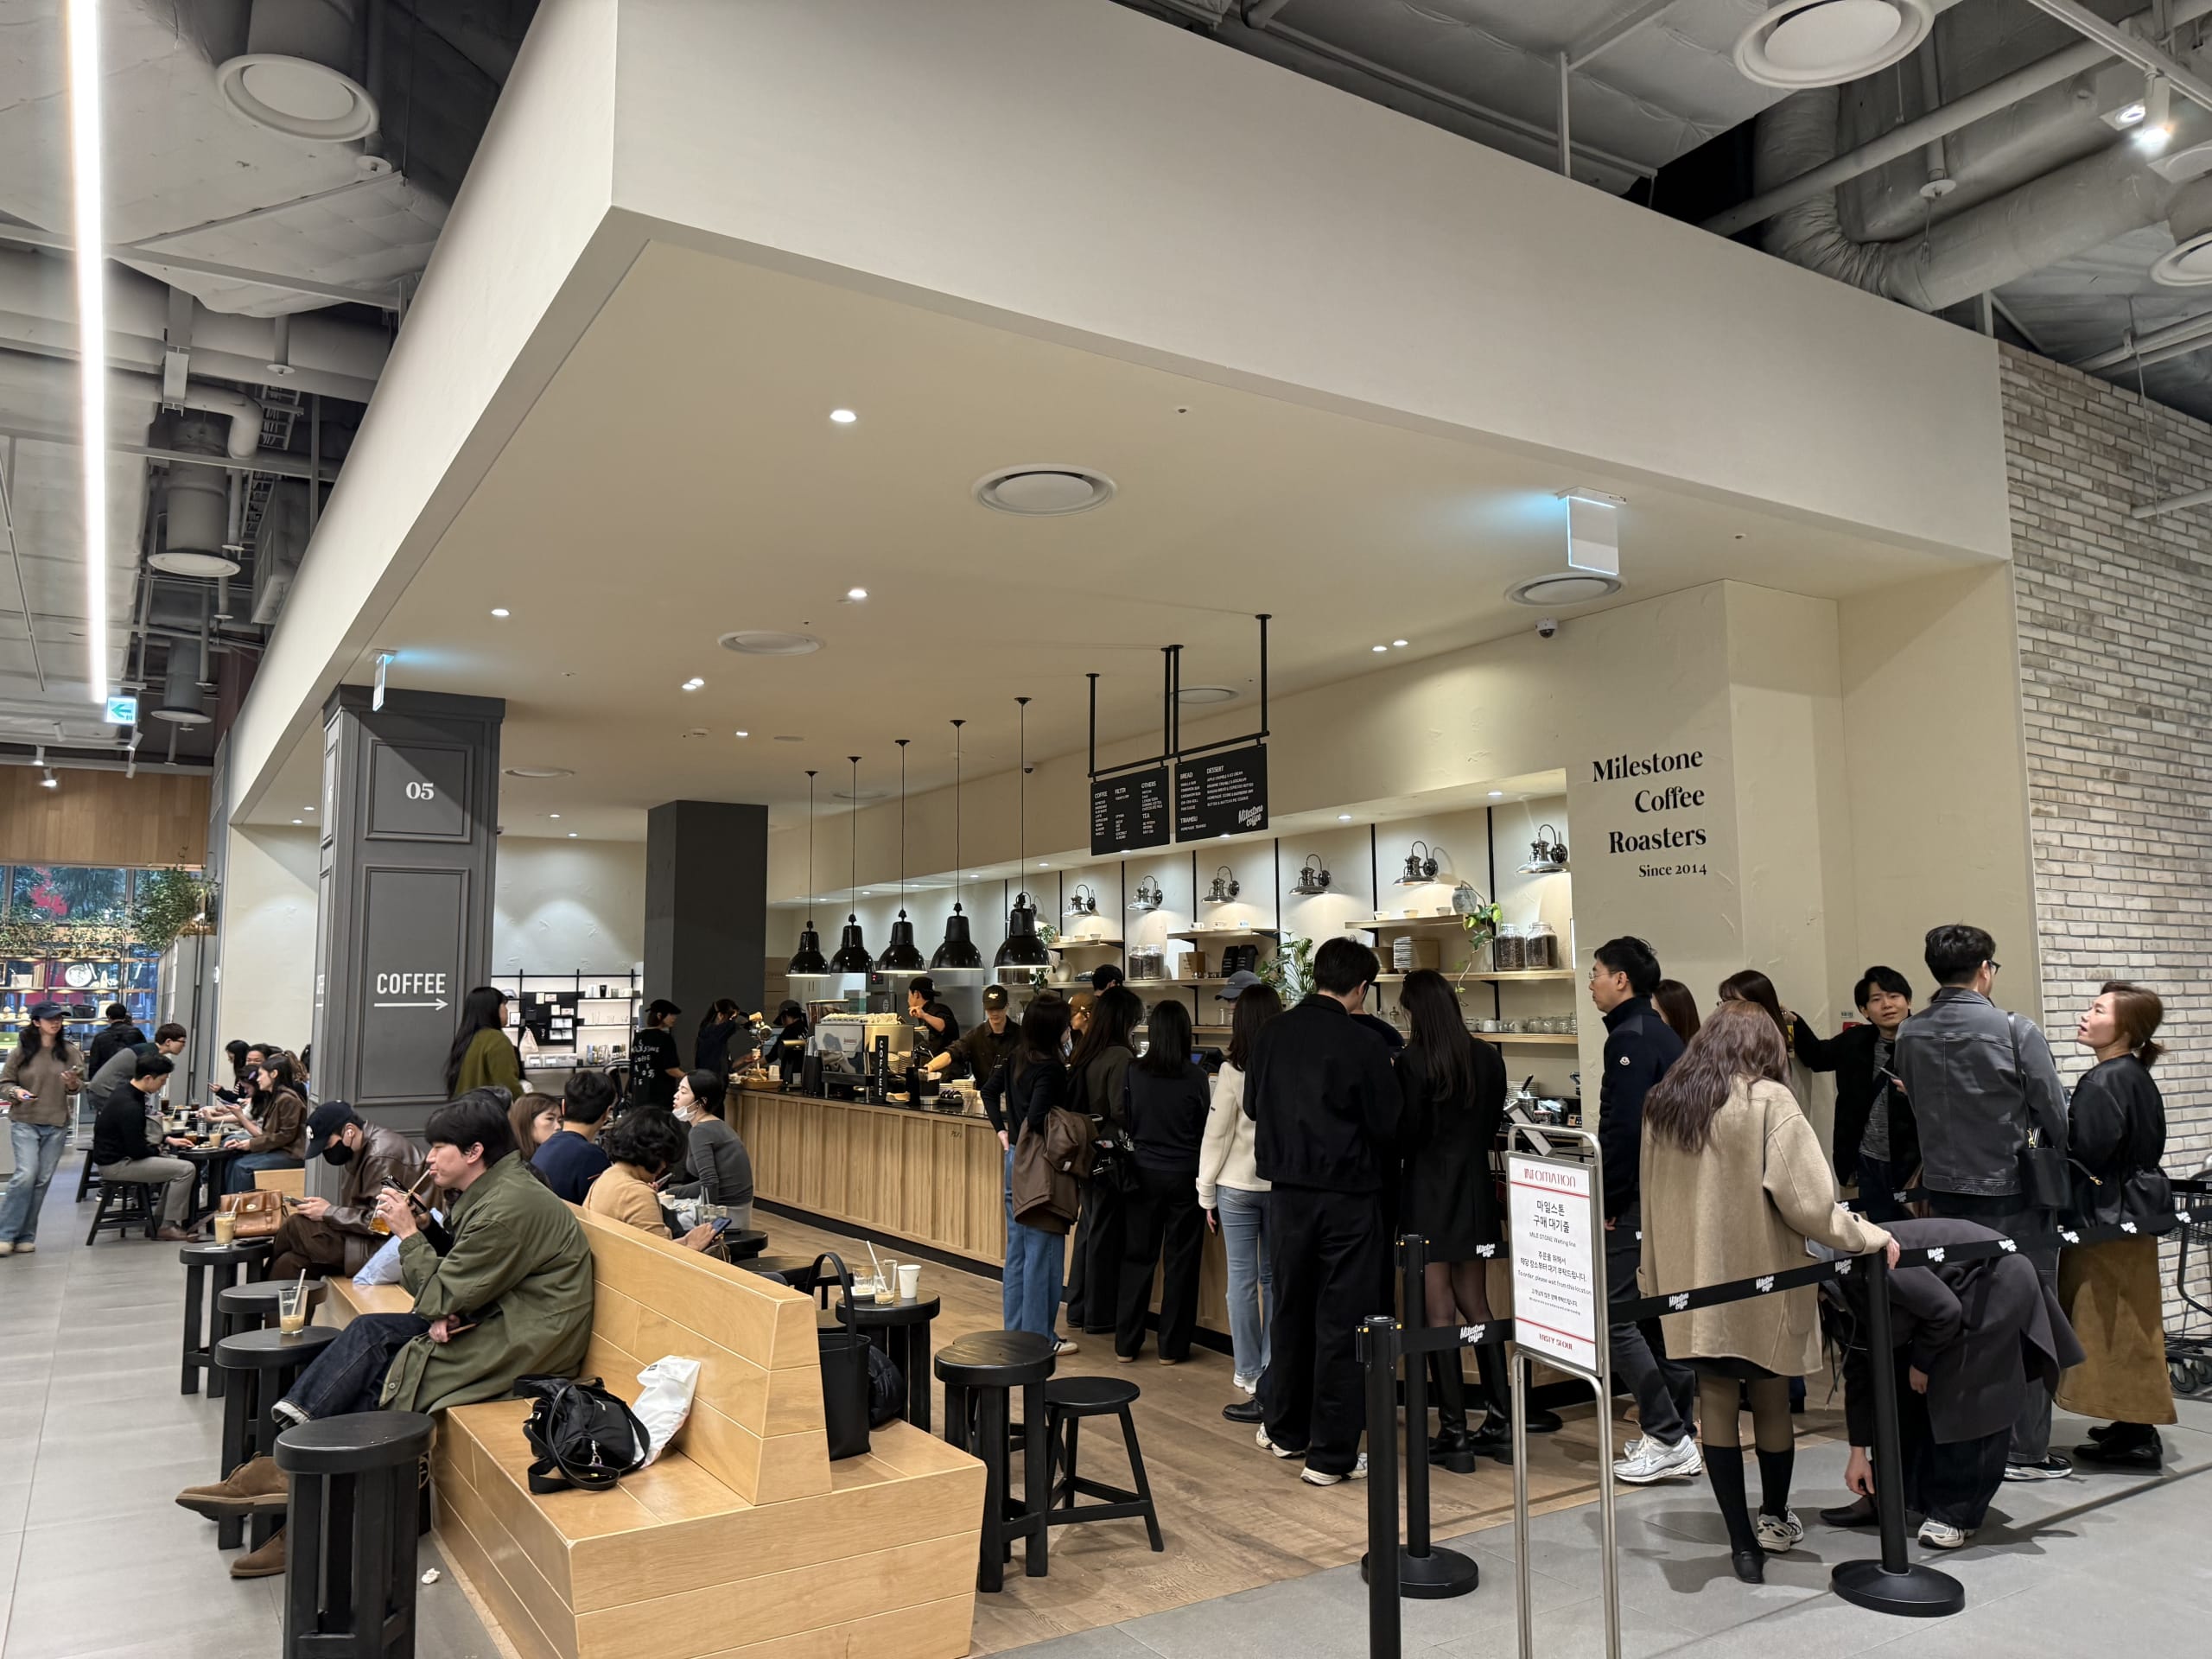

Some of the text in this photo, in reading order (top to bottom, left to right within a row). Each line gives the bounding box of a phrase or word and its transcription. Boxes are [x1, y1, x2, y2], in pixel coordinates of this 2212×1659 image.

[1207, 766, 1224, 774] DESSERT
[1592, 751, 1703, 782] Milestone
[406, 781, 435, 800] 05
[1635, 785, 1705, 813] Coffee
[1238, 804, 1263, 824] Milestone
[1609, 827, 1707, 854] Roasters
[1639, 864, 1707, 878] Since 2014
[377, 973, 446, 995] COFFEE
[1537, 1200, 1565, 1217] 마일스톤
[1534, 1215, 1569, 1233] 구매 대기줄
